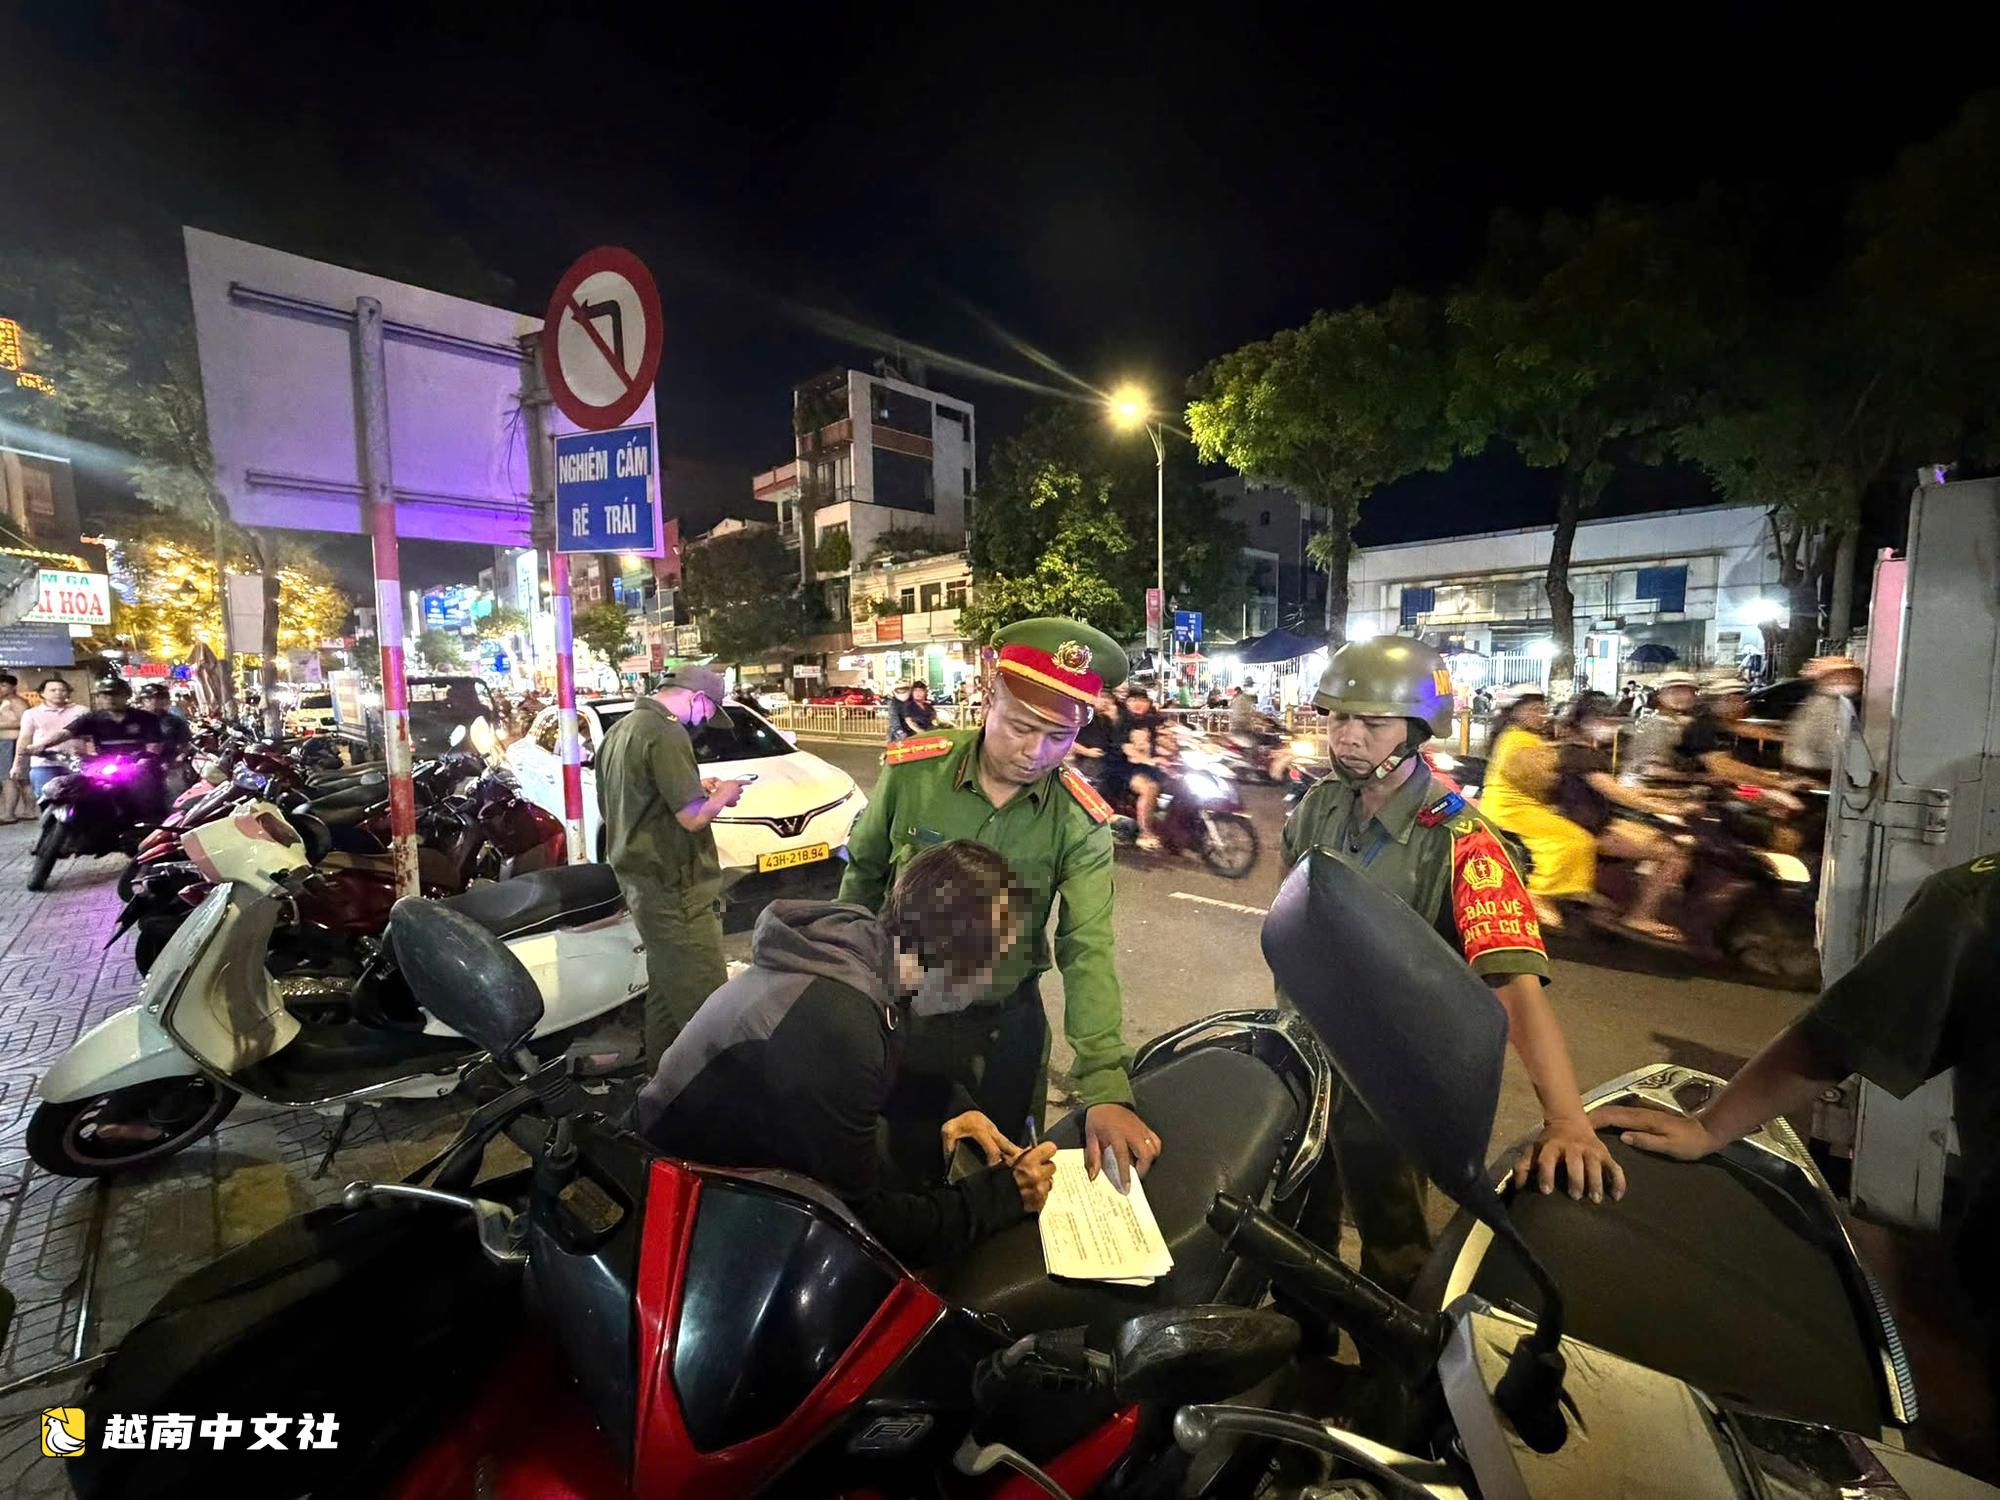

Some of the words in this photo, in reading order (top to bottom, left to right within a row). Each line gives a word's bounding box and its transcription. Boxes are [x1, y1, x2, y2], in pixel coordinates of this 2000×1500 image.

[559, 446, 608, 484] NGHIÊM
[616, 436, 648, 478] CẤM
[604, 496, 637, 535] TRÁI
[765, 847, 824, 868] 43H-218.94
